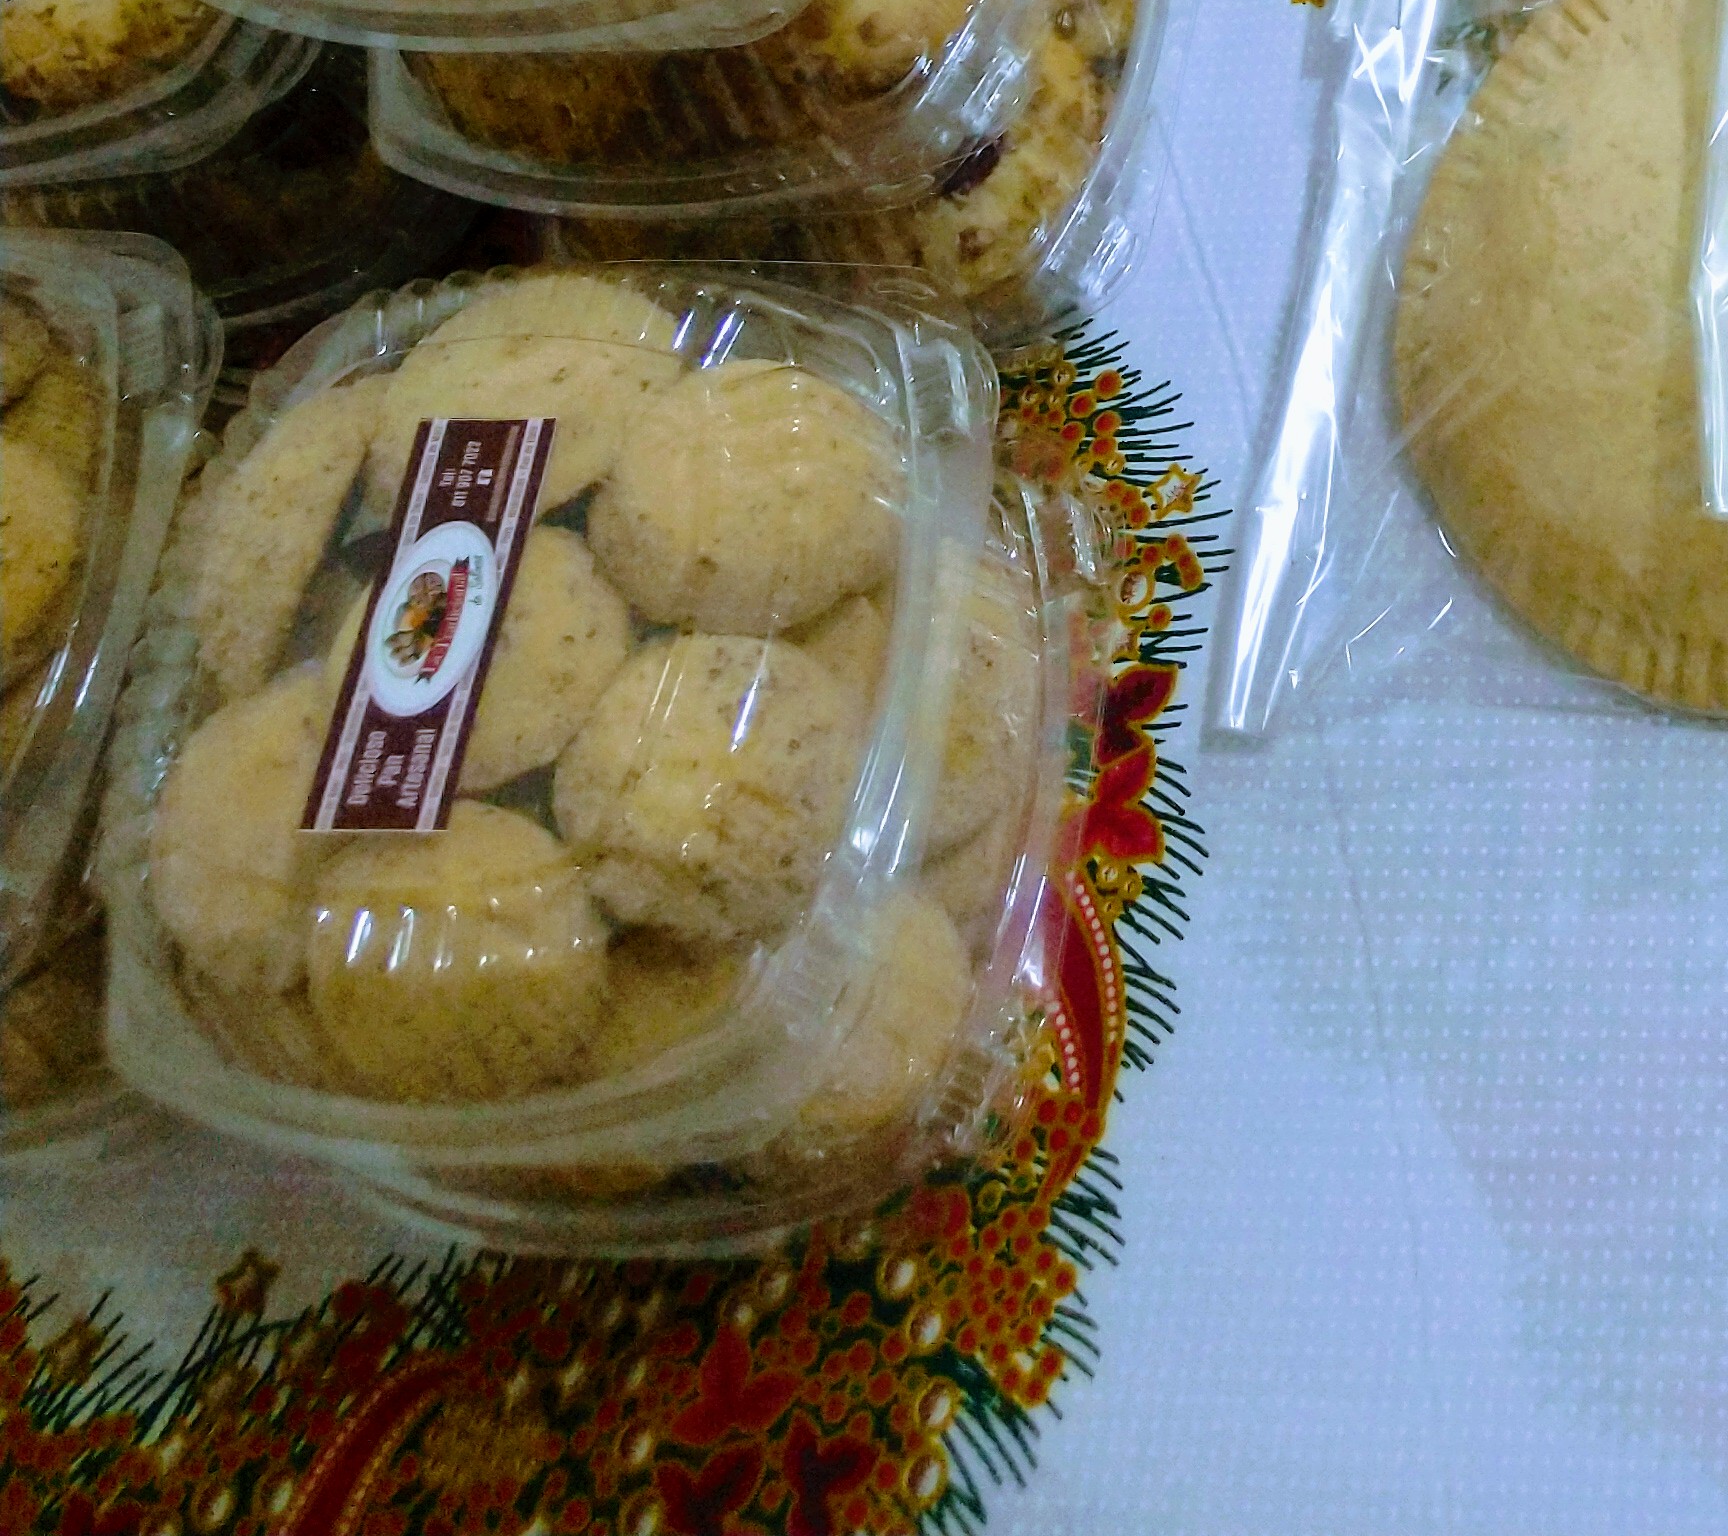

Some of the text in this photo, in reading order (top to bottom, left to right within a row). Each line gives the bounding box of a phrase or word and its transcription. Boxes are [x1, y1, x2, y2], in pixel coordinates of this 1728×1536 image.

[346, 729, 389, 806] Delicioso
[377, 754, 405, 787] Pan
[396, 727, 437, 810] Artesanal
